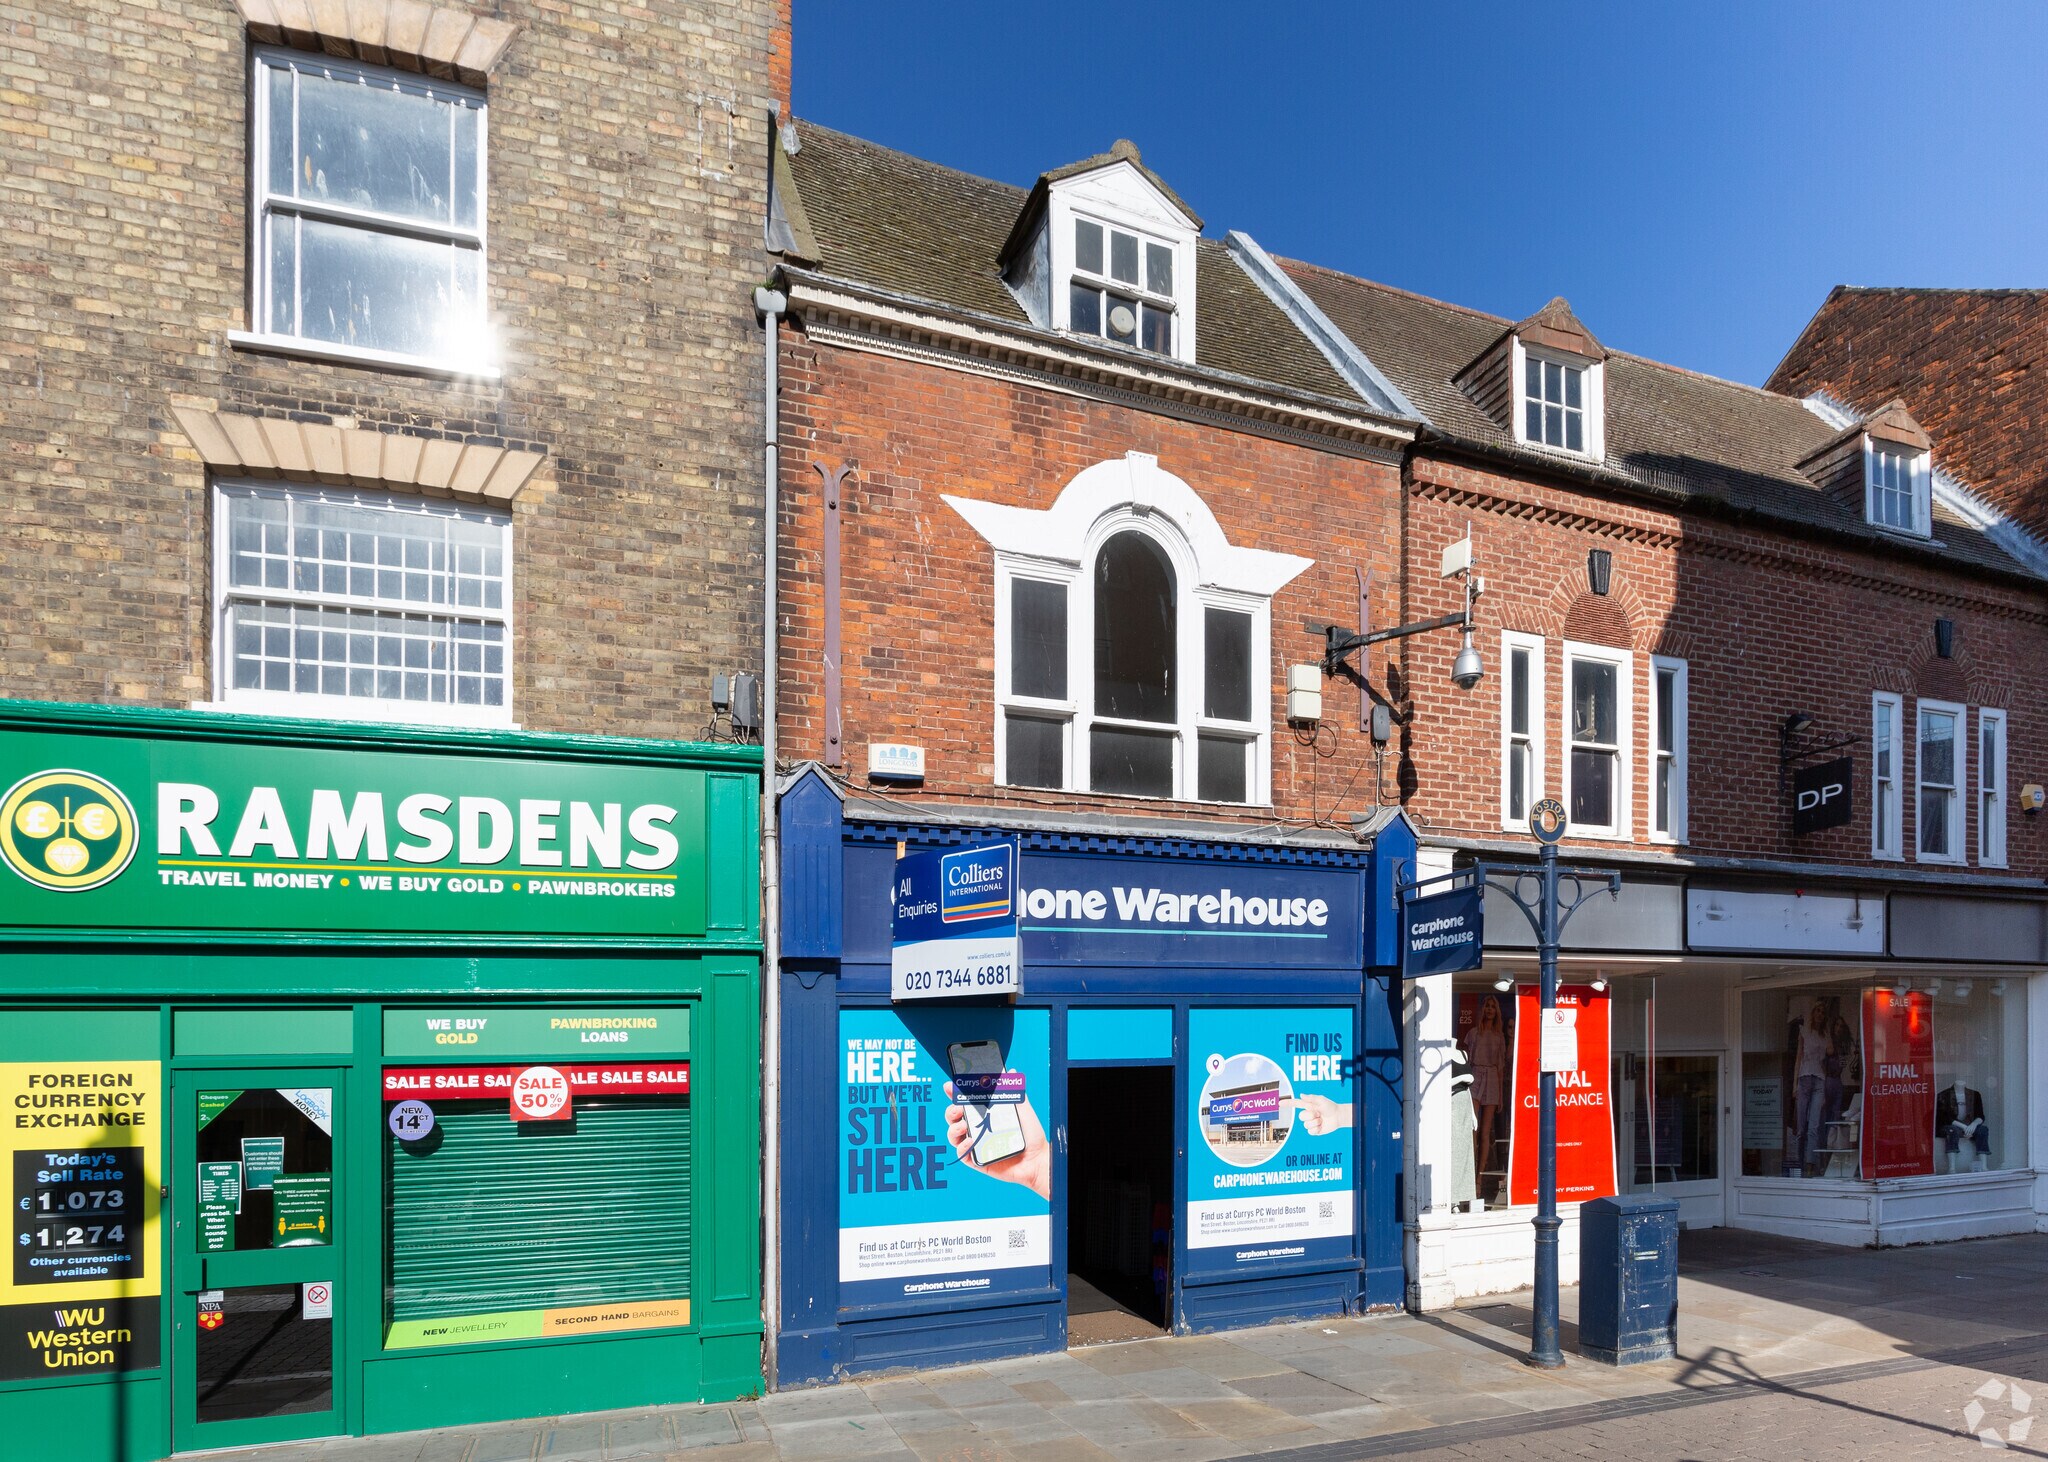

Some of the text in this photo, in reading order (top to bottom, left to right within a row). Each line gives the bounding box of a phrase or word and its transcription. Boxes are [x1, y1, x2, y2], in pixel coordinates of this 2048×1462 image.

[1798, 783, 1843, 811] DP
[1533, 800, 1565, 821] BOSTON
[158, 782, 679, 870] RAMSDENS
[158, 870, 334, 889] TRAVEL MONEY
[949, 863, 1003, 886] Colliers
[358, 875, 504, 893] WE BUY GOLD
[528, 880, 675, 897] PAWNBROKERS
[900, 878, 912, 897] All
[949, 882, 1003, 897] INTERNATIONAL
[899, 900, 938, 920] Enquiries
[1112, 886, 1328, 927] Warehouse
[1411, 915, 1464, 935] Carphone
[1411, 930, 1474, 951] Warehouse
[967, 950, 1012, 960] www.colliers.com/uk
[906, 964, 1011, 991] 020 7344 6881
[1889, 998, 1908, 1007] SALE
[426, 1018, 487, 1030] WE BUY
[551, 1018, 657, 1029] PAWNBROKING
[436, 1033, 478, 1044] GOLD
[581, 1031, 628, 1043] LOANS
[848, 1038, 916, 1050] WE MAY NOT BE
[1286, 1033, 1342, 1053] FIND US
[847, 1051, 932, 1083] HERE...
[1293, 1054, 1342, 1082] HERE
[1879, 1064, 1919, 1079] FINAL
[29, 1074, 133, 1088] FOREIGN
[386, 1075, 431, 1089] SALE
[435, 1074, 479, 1088] SALE
[519, 1077, 562, 1089] SALE
[602, 1070, 643, 1083] SALE
[646, 1070, 687, 1083] SALE
[956, 1078, 980, 1087] Currys
[848, 1085, 881, 1104] BUT
[957, 1093, 986, 1101] Carphone
[1870, 1082, 1928, 1096] CLEARANCE
[15, 1093, 145, 1108] CURRENCY
[295, 1090, 330, 1120] LOGBOOK
[1212, 1104, 1233, 1112] Currys
[1254, 1097, 1276, 1107] World
[294, 1099, 320, 1120] MONEY
[16, 1112, 145, 1128] EXCHANGE
[848, 1106, 935, 1145] STILL
[1286, 1152, 1342, 1167] OR ONLINE AT
[37, 1169, 124, 1182] Sell Rate
[848, 1146, 948, 1194] HERE
[1214, 1168, 1342, 1188] CARPHONEWAREHOUSE.COM
[20, 1190, 124, 1210] € 1.073
[1201, 1212, 1214, 1220] Find
[1225, 1211, 1232, 1219] at
[1233, 1209, 1254, 1220] Currys
[1255, 1208, 1264, 1217] PC
[1266, 1207, 1284, 1216] World
[1285, 1205, 1306, 1214] Boston
[19, 1225, 125, 1246] $ 1.274
[859, 1234, 992, 1252] Find us at Currys PC World Boston
[29, 1254, 131, 1267] Other currencies
[1236, 1246, 1305, 1259] Carphone Warehouse
[53, 1267, 109, 1277] available
[904, 1278, 990, 1293] Carphone Warehouse
[201, 1302, 221, 1312] NPA
[60, 1307, 105, 1328] WU
[555, 1309, 680, 1326] SECOND HAND BARGAINS
[423, 1321, 508, 1337] NEW JEWELLERY
[27, 1328, 132, 1349] Western
[44, 1346, 114, 1368] Union
